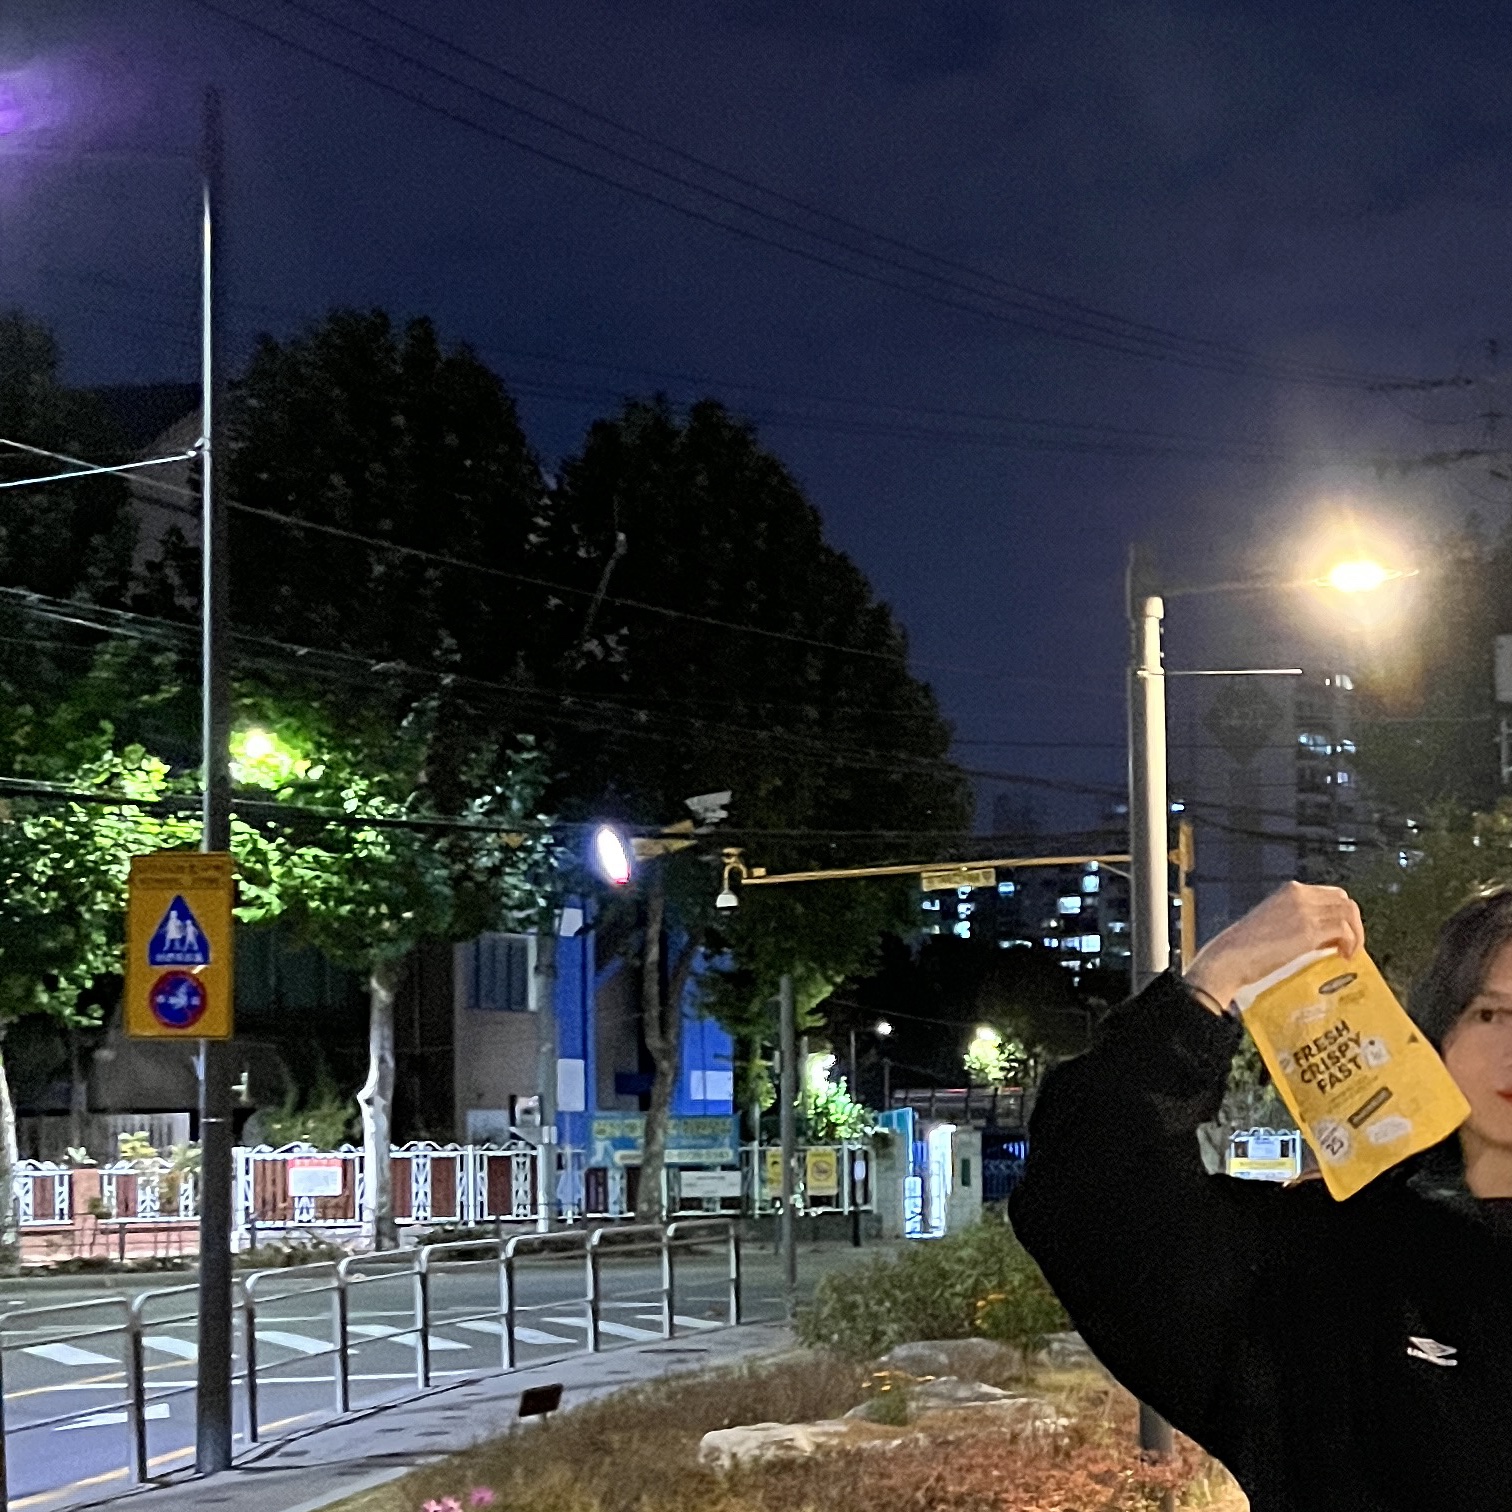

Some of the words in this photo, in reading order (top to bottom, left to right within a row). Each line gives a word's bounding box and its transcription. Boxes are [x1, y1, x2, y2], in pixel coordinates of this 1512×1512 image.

[1293, 1019, 1350, 1068] FRESH
[1300, 1031, 1361, 1084] CRISPY
[1316, 1054, 1362, 1095] FAST
